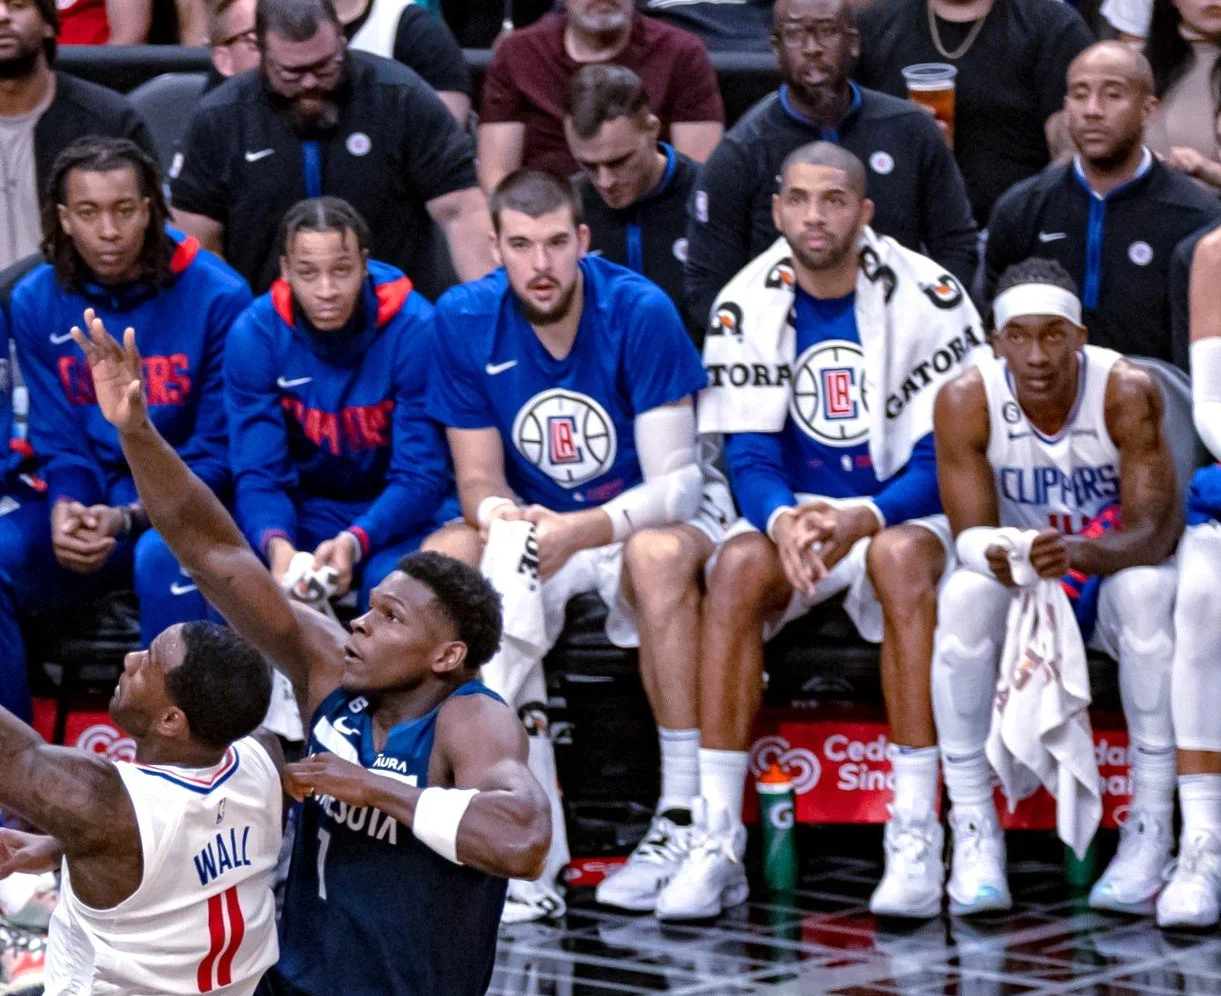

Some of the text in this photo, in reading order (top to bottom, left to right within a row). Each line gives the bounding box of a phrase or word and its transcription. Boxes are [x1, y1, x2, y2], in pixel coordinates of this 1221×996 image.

[193, 826, 252, 887] WALL
[317, 827, 331, 900] 1
[197, 885, 245, 994] 11
